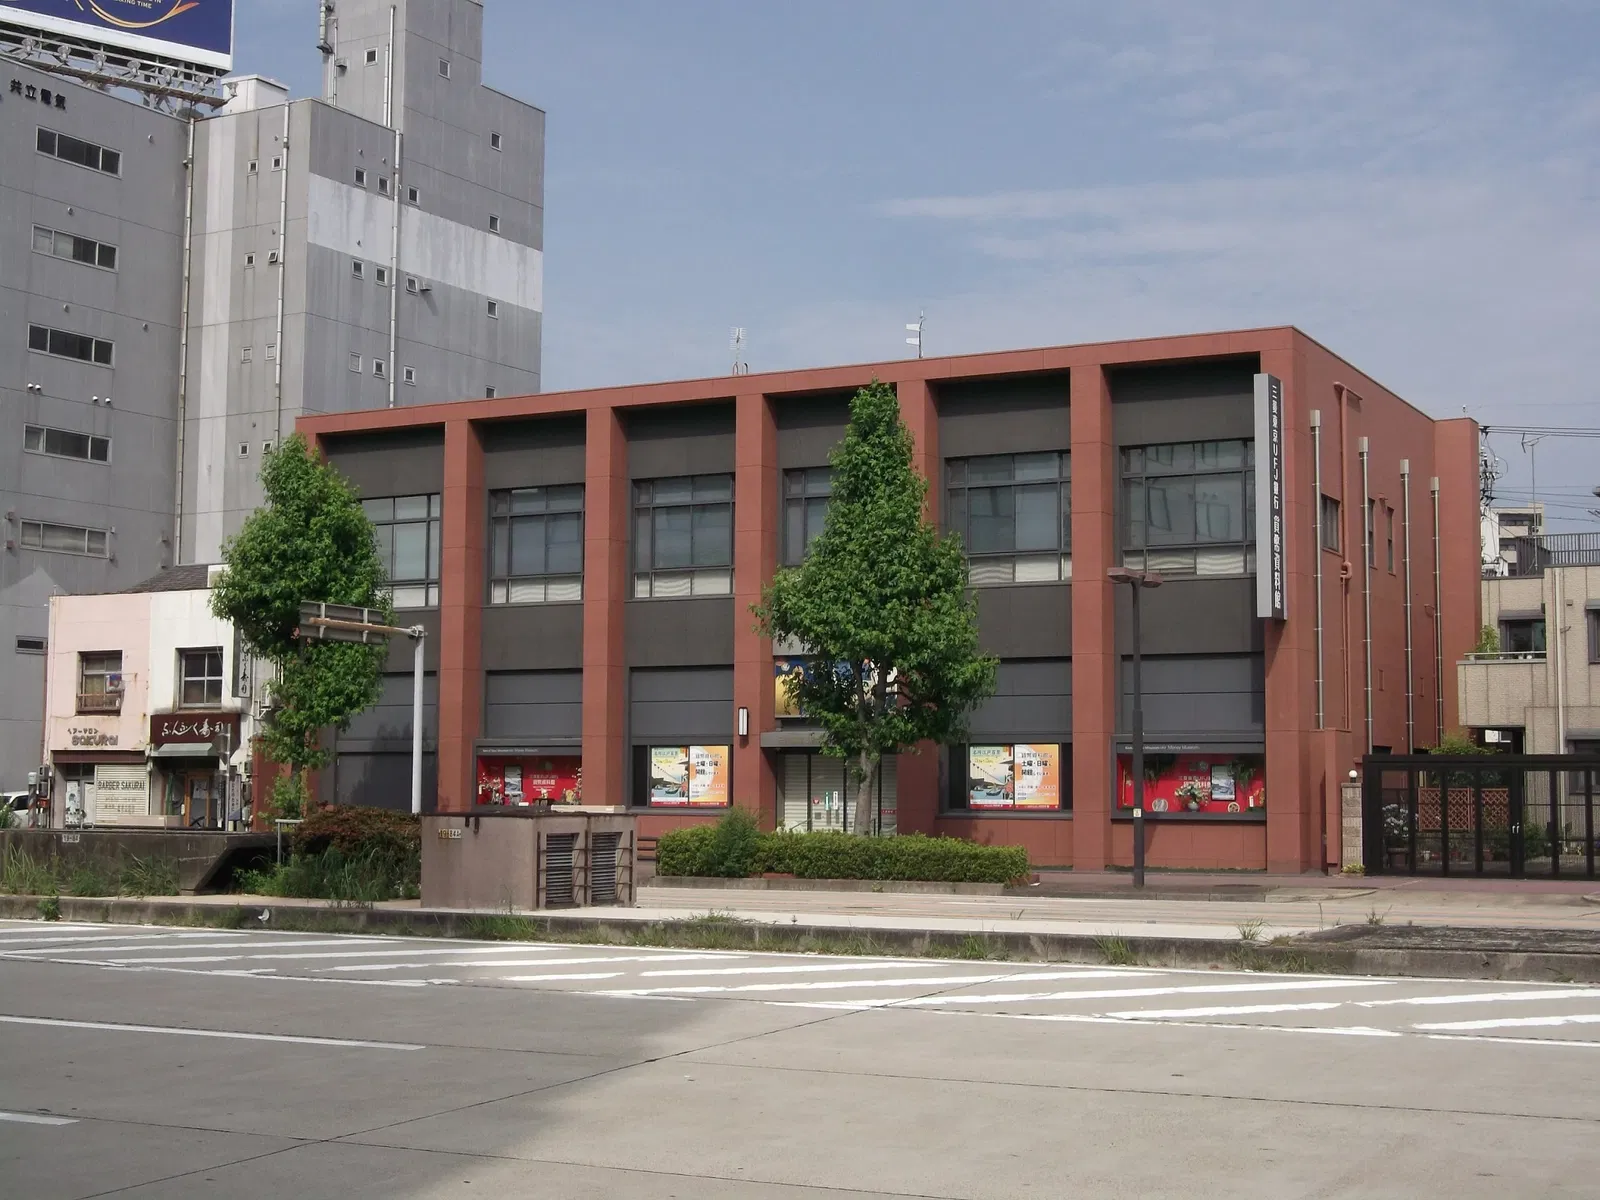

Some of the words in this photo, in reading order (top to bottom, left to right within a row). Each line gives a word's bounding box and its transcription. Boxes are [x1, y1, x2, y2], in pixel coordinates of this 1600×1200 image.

[137, 1, 152, 9] TIME
[97, 780, 120, 790] BARBER
[121, 780, 145, 791] SAKURAI
